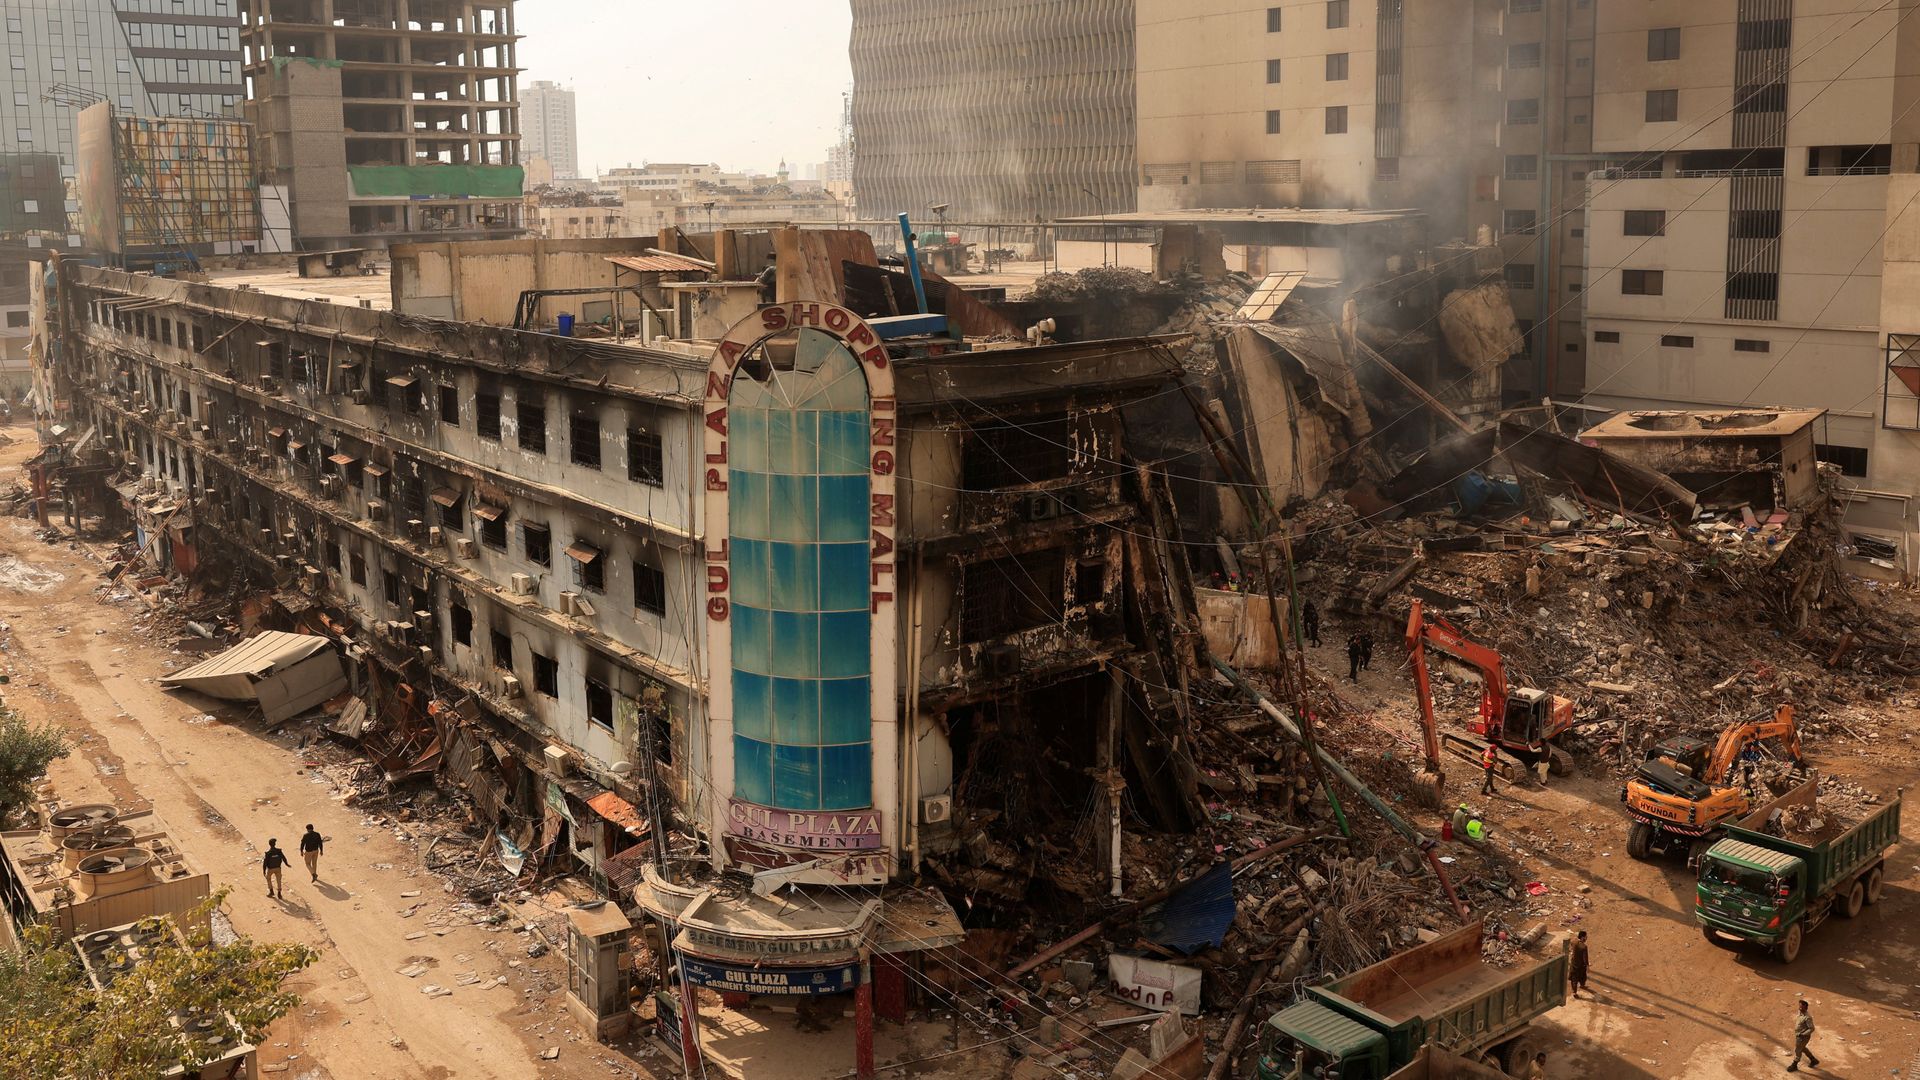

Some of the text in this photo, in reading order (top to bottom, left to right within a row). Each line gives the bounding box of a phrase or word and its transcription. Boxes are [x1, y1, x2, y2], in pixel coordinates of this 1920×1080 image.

[706, 340, 746, 491] PLAZA
[871, 494, 894, 614] MALL
[707, 538, 729, 621] GUL
[730, 803, 881, 835] GUL PLAZA
[1640, 802, 1677, 819] HYUNDAI
[743, 826, 865, 848] BASEMENT
[725, 970, 749, 983] GUL
[750, 972, 789, 986] PLAZA
[745, 984, 788, 994] SHOPPING
[789, 985, 812, 994] MALL
[1110, 979, 1142, 1001] Red
[1146, 992, 1156, 1005] n
